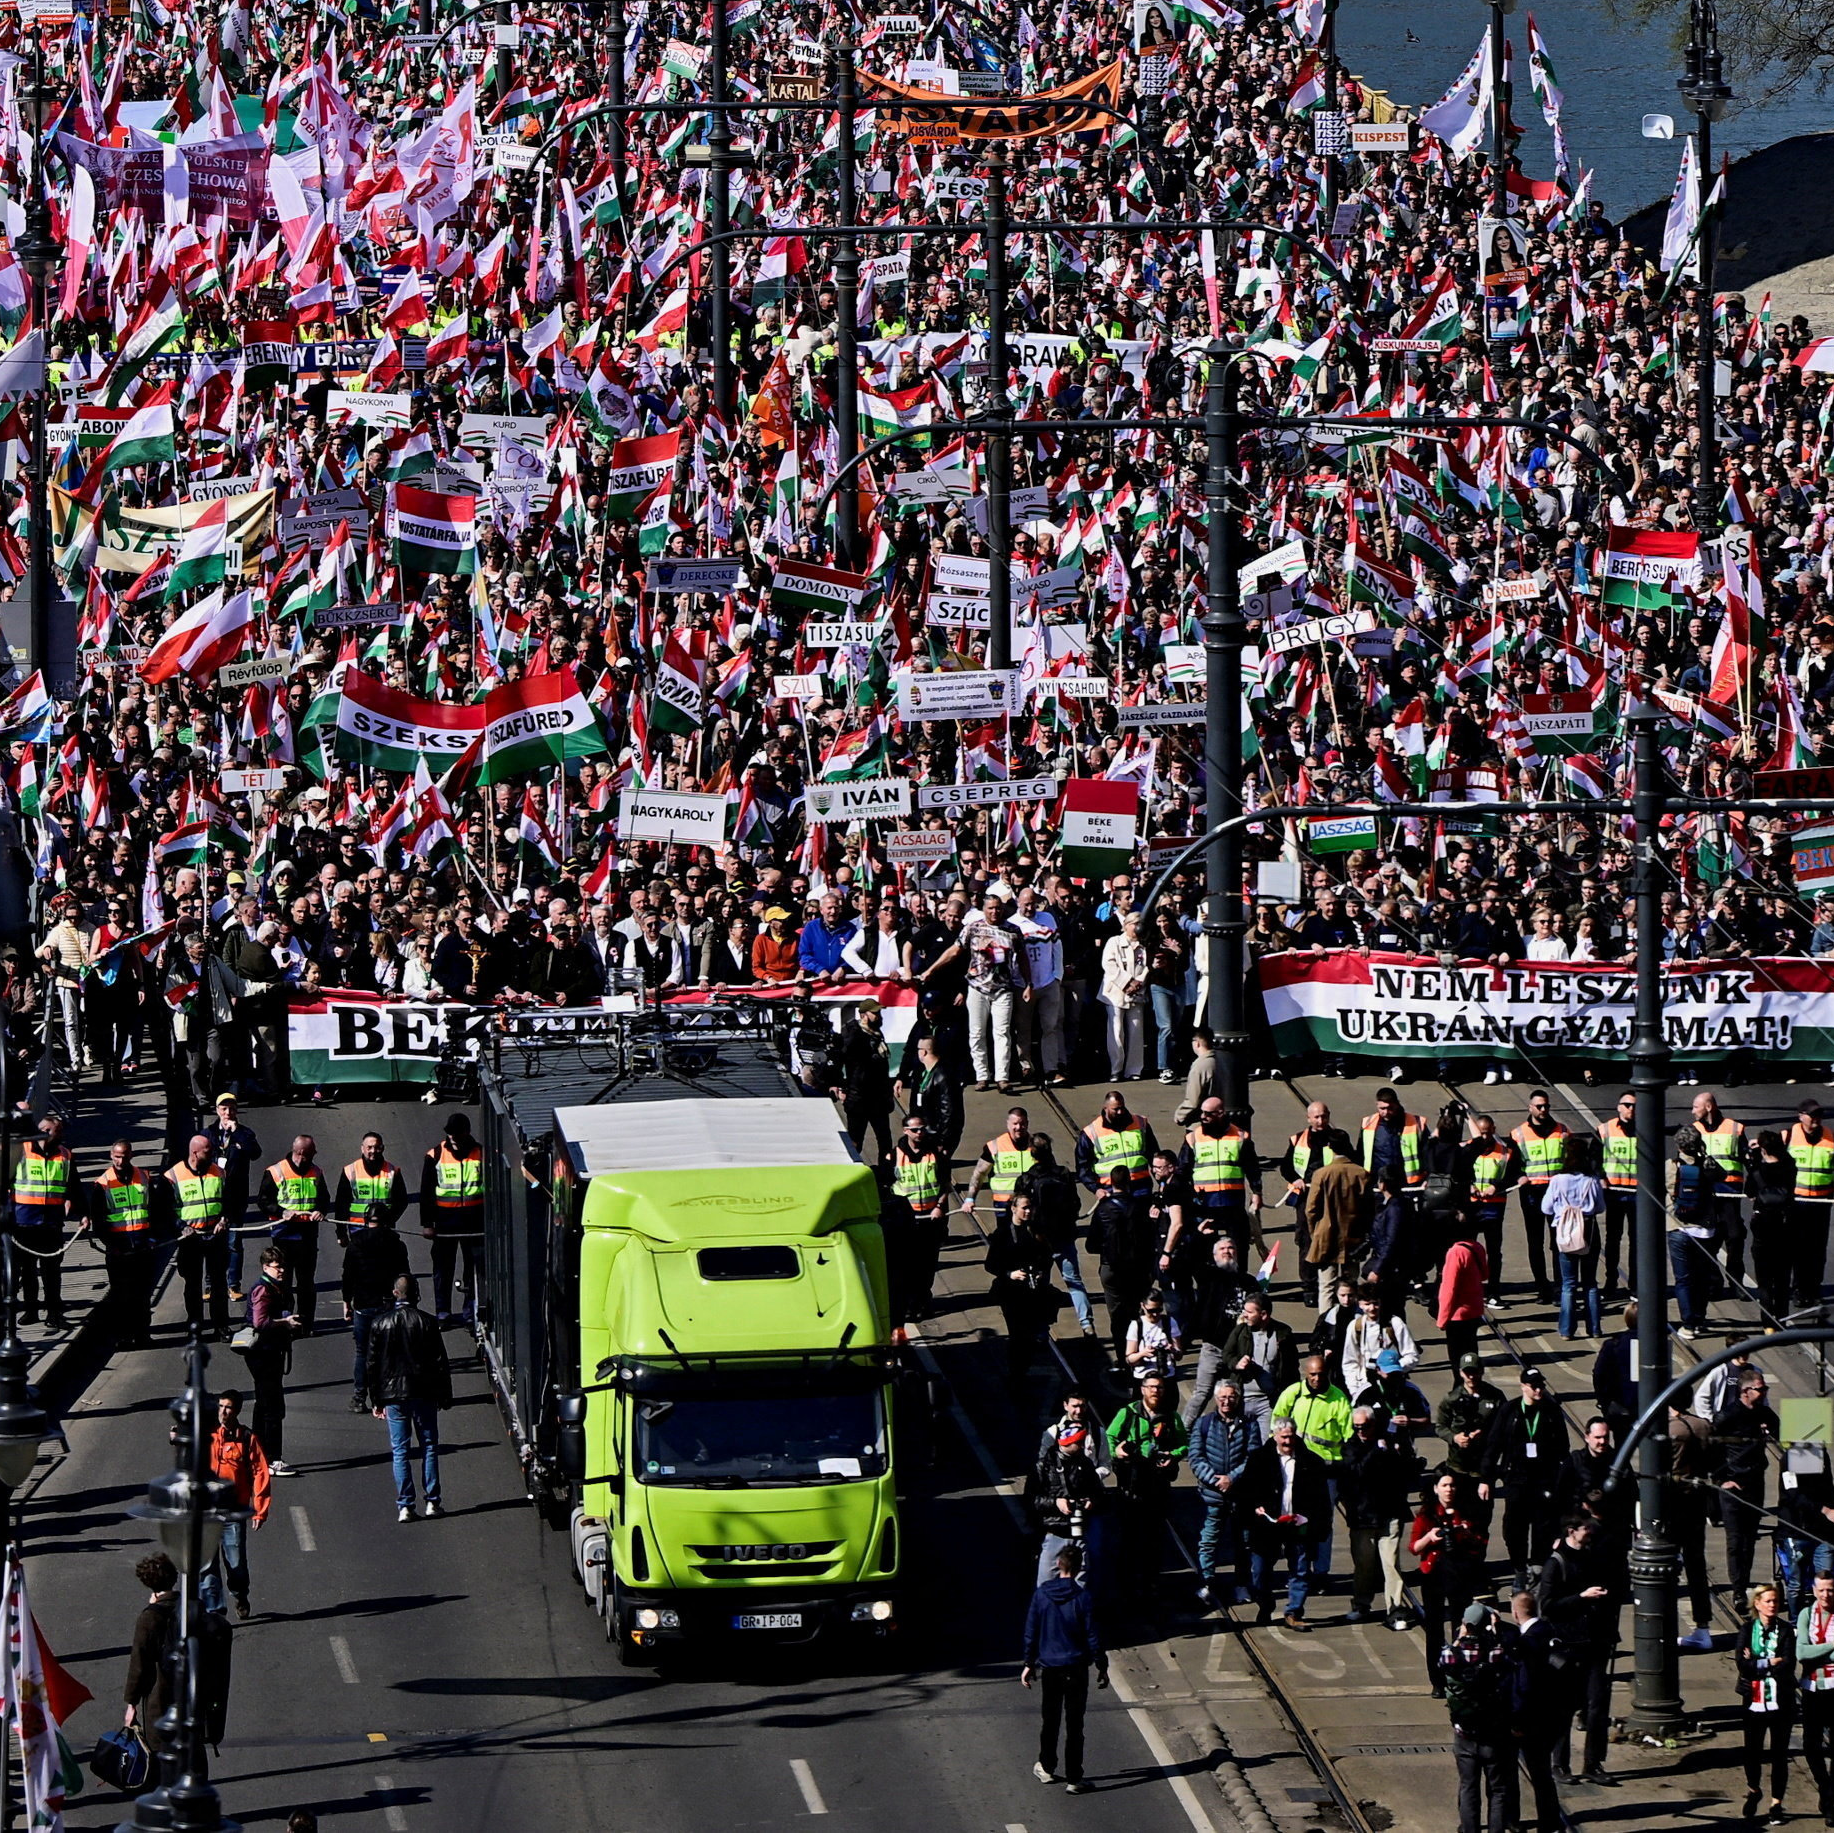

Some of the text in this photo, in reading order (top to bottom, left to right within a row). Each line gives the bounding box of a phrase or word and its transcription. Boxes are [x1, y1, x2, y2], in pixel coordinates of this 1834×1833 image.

[878, 18, 917, 34] VÁLLAJ
[770, 82, 818, 101] KARTAL
[1315, 111, 1347, 119] TISZA
[473, 135, 517, 149] APOLCA
[1315, 129, 1347, 137] TISZA
[1315, 138, 1347, 146] TISZA
[1353, 132, 1407, 142] KISPEST
[1315, 147, 1347, 155] TISZA
[122, 167, 248, 193] CZĘSCHOWA
[935, 179, 984, 197] PÉCS
[1374, 340, 1440, 351] KISKUNMAJSA
[61, 384, 89, 402] PÉ
[492, 420, 517, 430] KURD
[679, 569, 735, 581] DERECSKE
[783, 576, 854, 601] DOMONY
[938, 598, 989, 622] Szűc
[809, 624, 875, 643] TISZASÜ
[228, 662, 283, 683] Révfülöp
[781, 679, 815, 695] SZIL
[1009, 673, 1017, 712] Derecske
[1038, 679, 1107, 697] NYÍCSAHOLY
[1529, 716, 1586, 731] JÁSZAPÁTI
[240, 770, 265, 788] TÉT
[842, 786, 900, 807] IVÁN
[930, 782, 1048, 804] CSEPREG
[631, 802, 715, 823] NAGYKÁROLY
[1087, 815, 1112, 827] BÉKE
[1082, 831, 1115, 845] ORBÁN
[1311, 819, 1374, 839] JÁSZSÁG
[892, 833, 946, 848] ACSALAG
[1374, 968, 1489, 1003] NEM
[1337, 1005, 1514, 1044] UKRÁN
[723, 1544, 807, 1562] IVECO
[741, 1613, 800, 1628] GR IP-004
